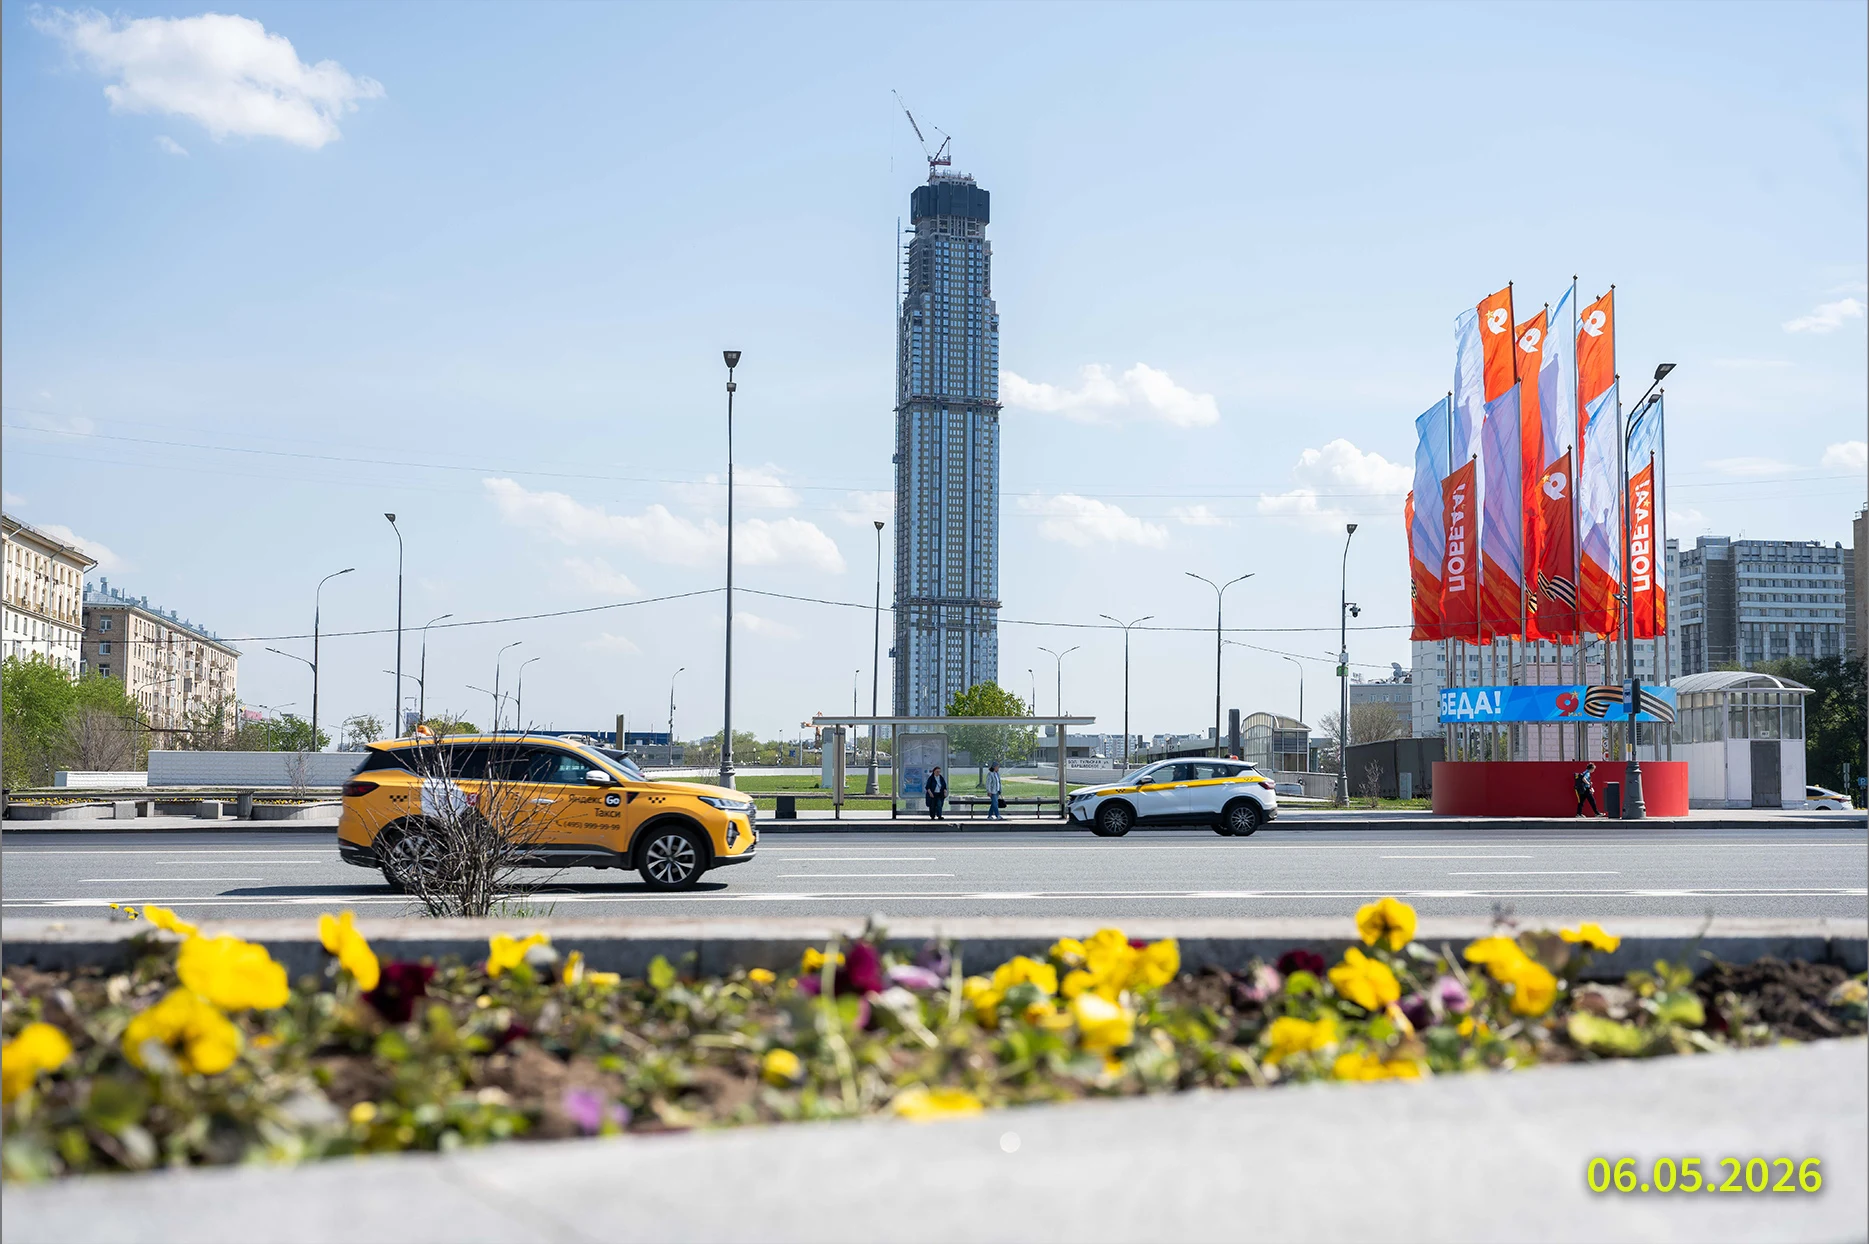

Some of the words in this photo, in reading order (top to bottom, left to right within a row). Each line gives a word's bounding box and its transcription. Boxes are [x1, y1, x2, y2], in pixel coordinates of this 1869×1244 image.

[606, 795, 620, 805] Go
[594, 808, 621, 818] Такси
[584, 822, 621, 831] 999-99-99
